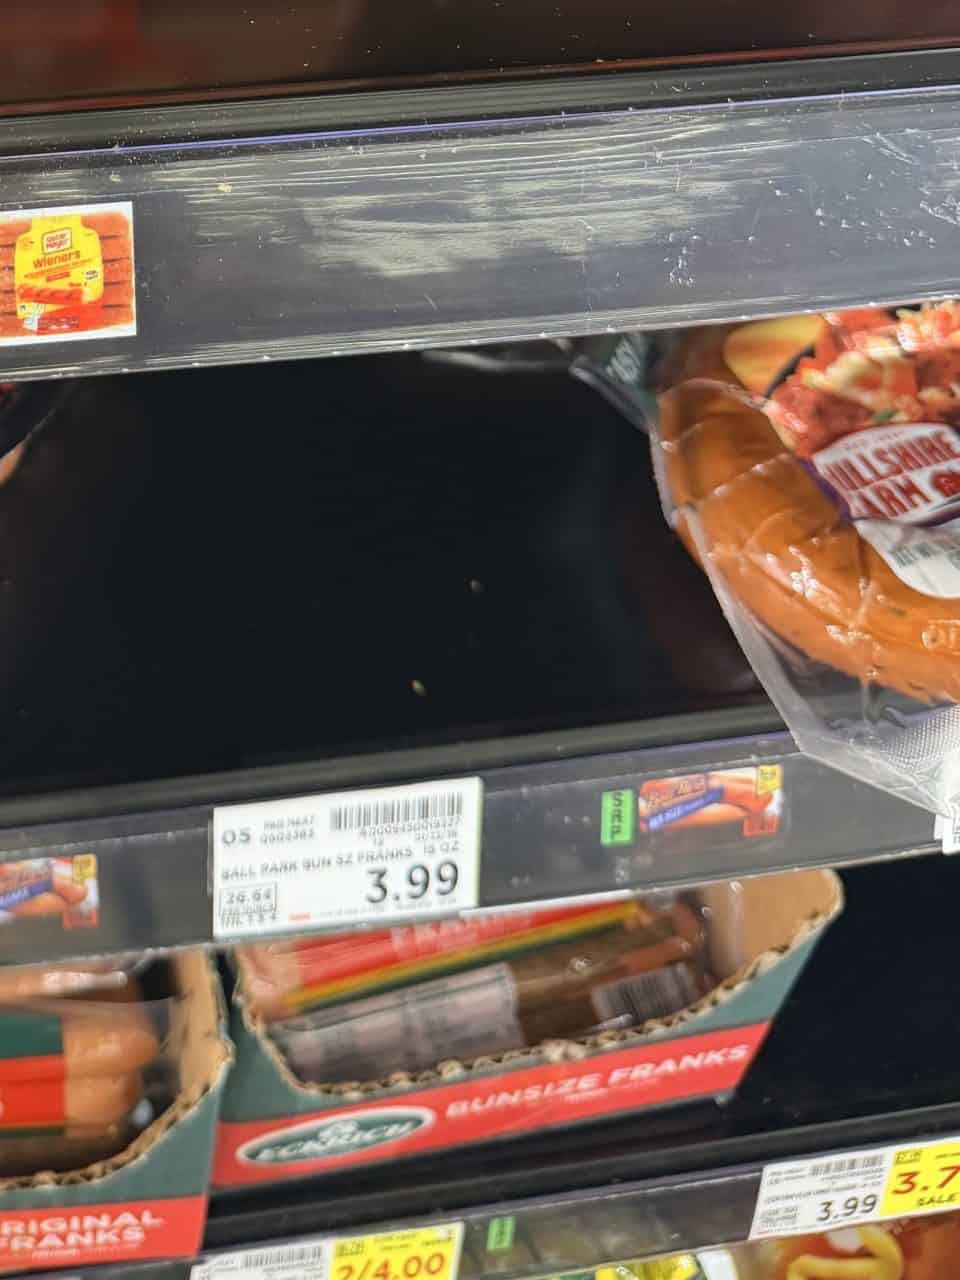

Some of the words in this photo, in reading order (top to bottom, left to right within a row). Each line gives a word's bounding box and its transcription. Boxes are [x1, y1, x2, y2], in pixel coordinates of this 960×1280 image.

[357, 848, 413, 863] FRANKS
[366, 860, 459, 904] 3.99
[446, 1072, 601, 1119] BUNSIZE
[609, 1043, 749, 1086] FRANKS
[816, 1193, 878, 1222] 3.99
[336, 1252, 446, 1280] 2/4.00
